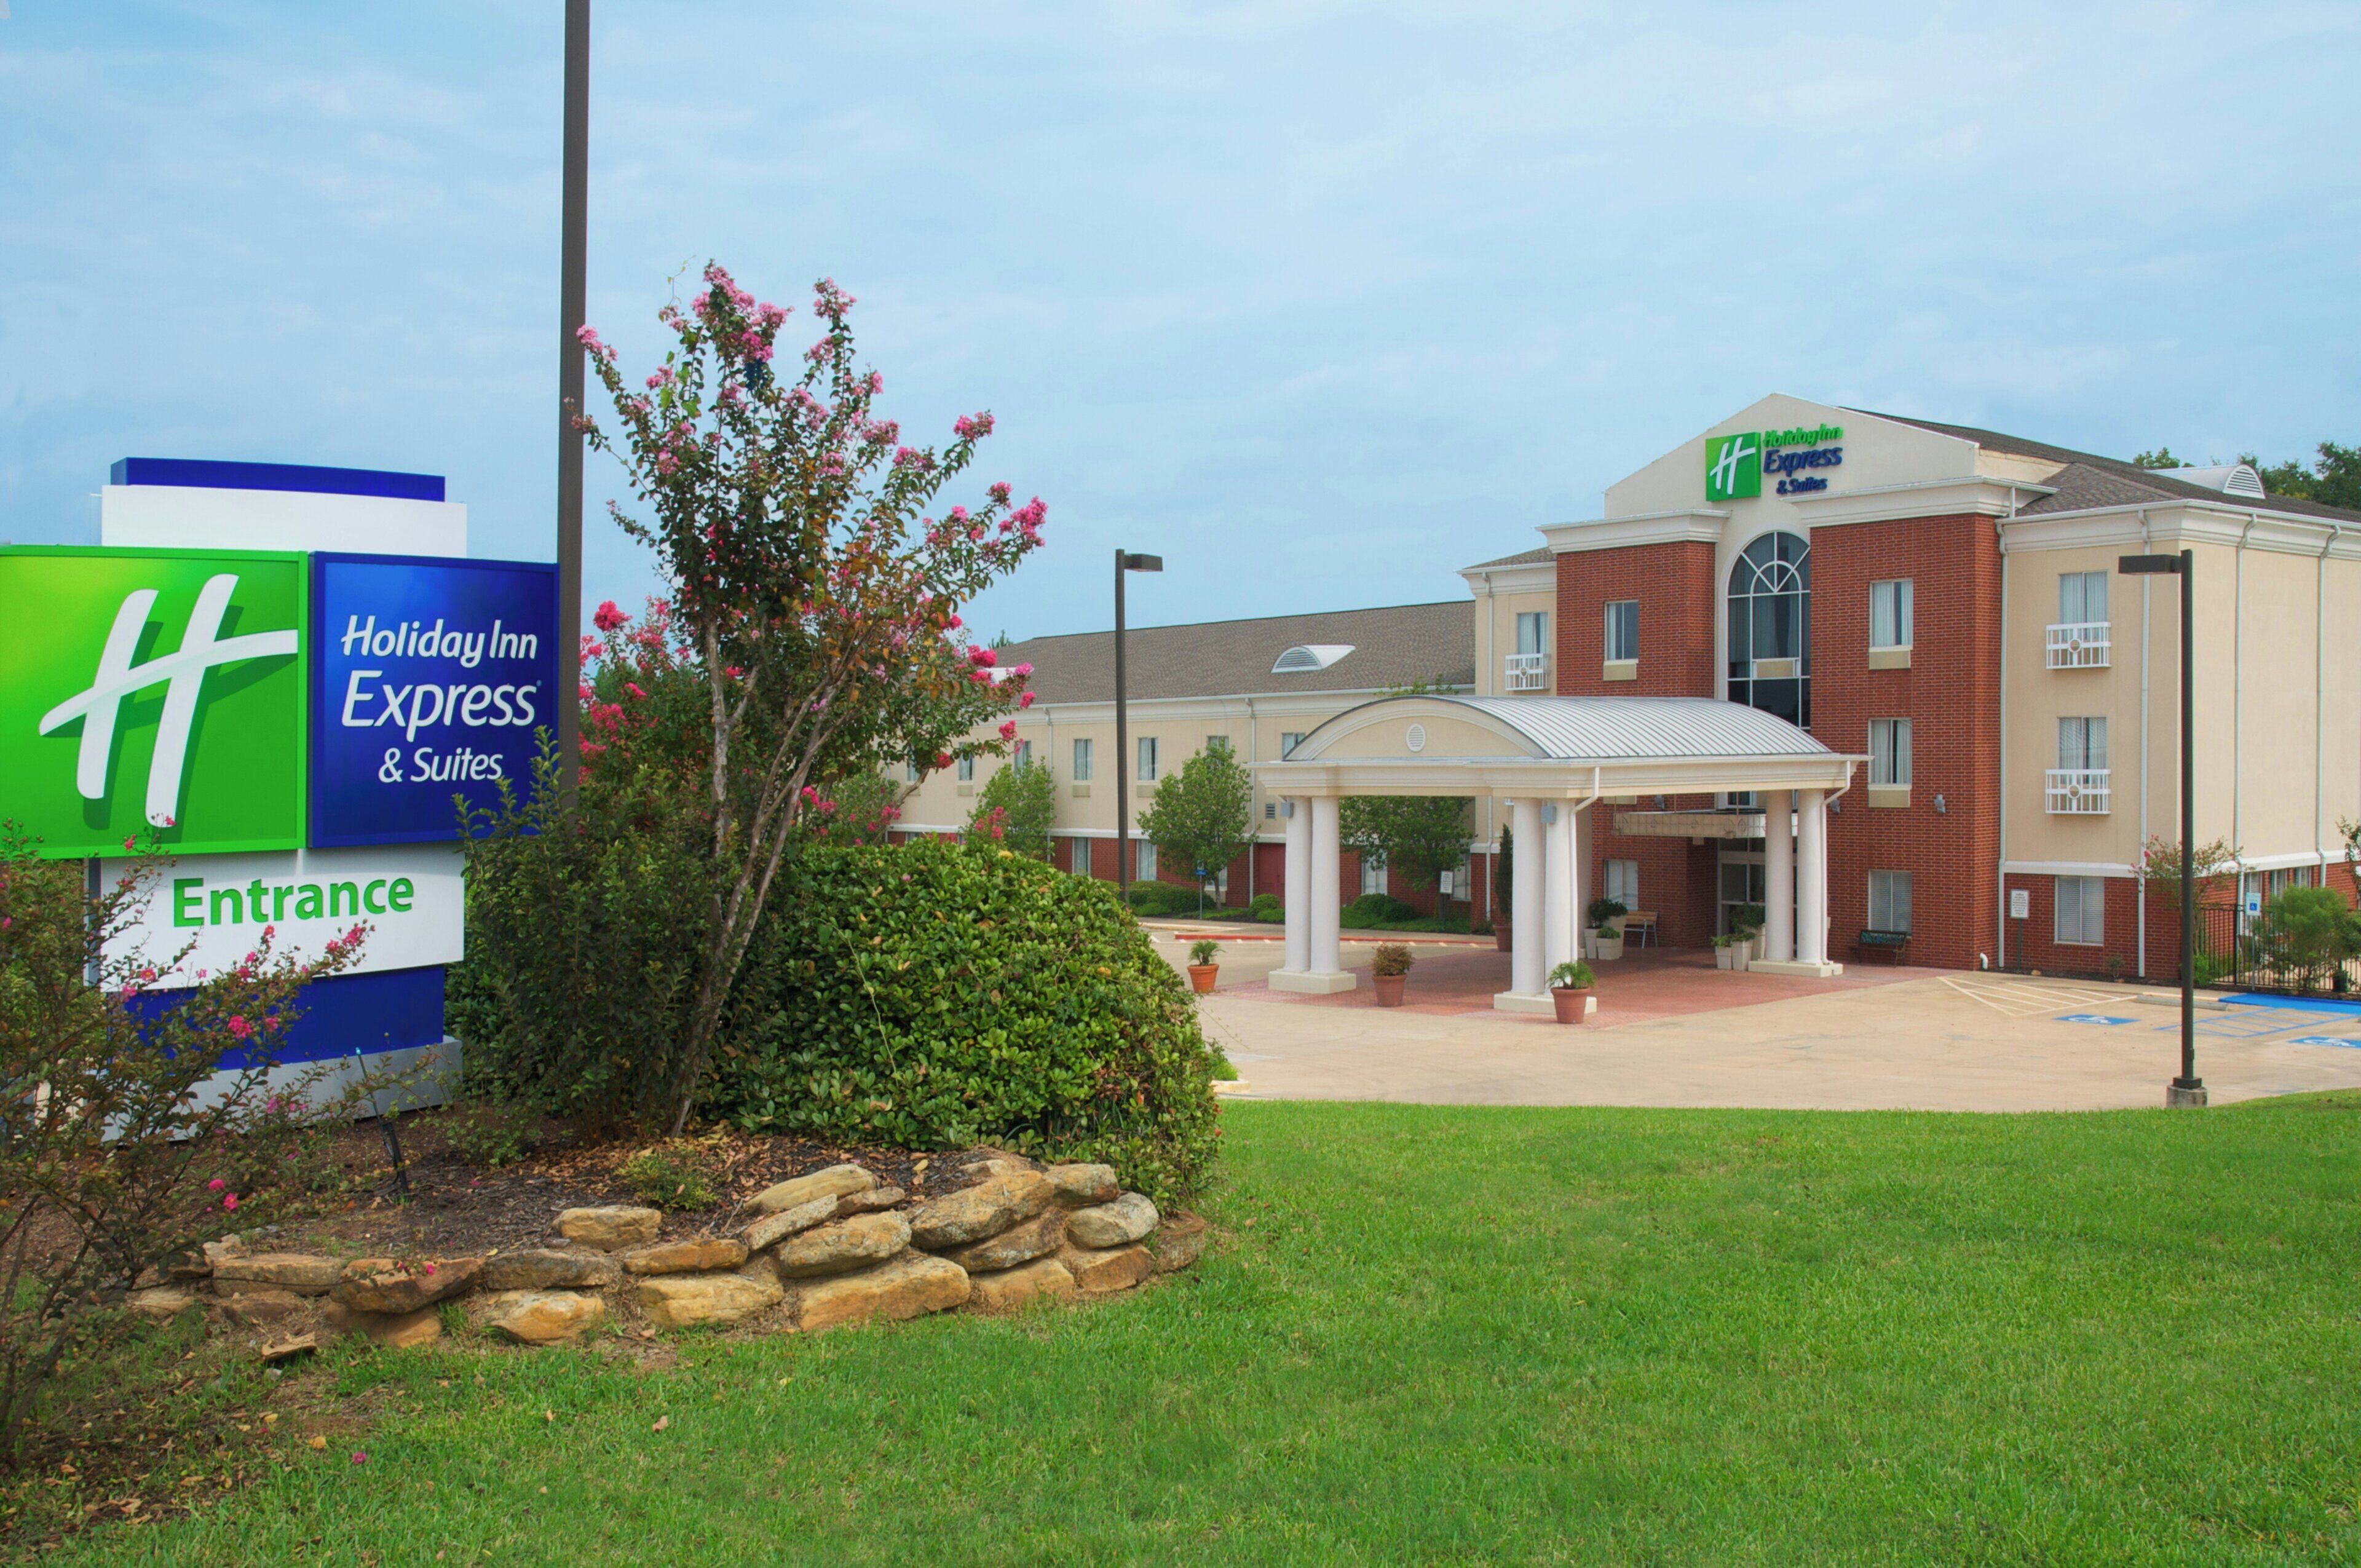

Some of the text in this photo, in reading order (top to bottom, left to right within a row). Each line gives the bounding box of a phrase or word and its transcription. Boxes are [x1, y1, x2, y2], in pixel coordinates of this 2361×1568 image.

[1763, 424, 1843, 447] Holiday Inn
[1763, 447, 1843, 477] Express
[1776, 477, 1828, 494] & Suites
[341, 615, 538, 668] Holiday Inn
[342, 670, 537, 742] Express
[378, 747, 504, 783] & Suites
[173, 877, 414, 927] Entrance
